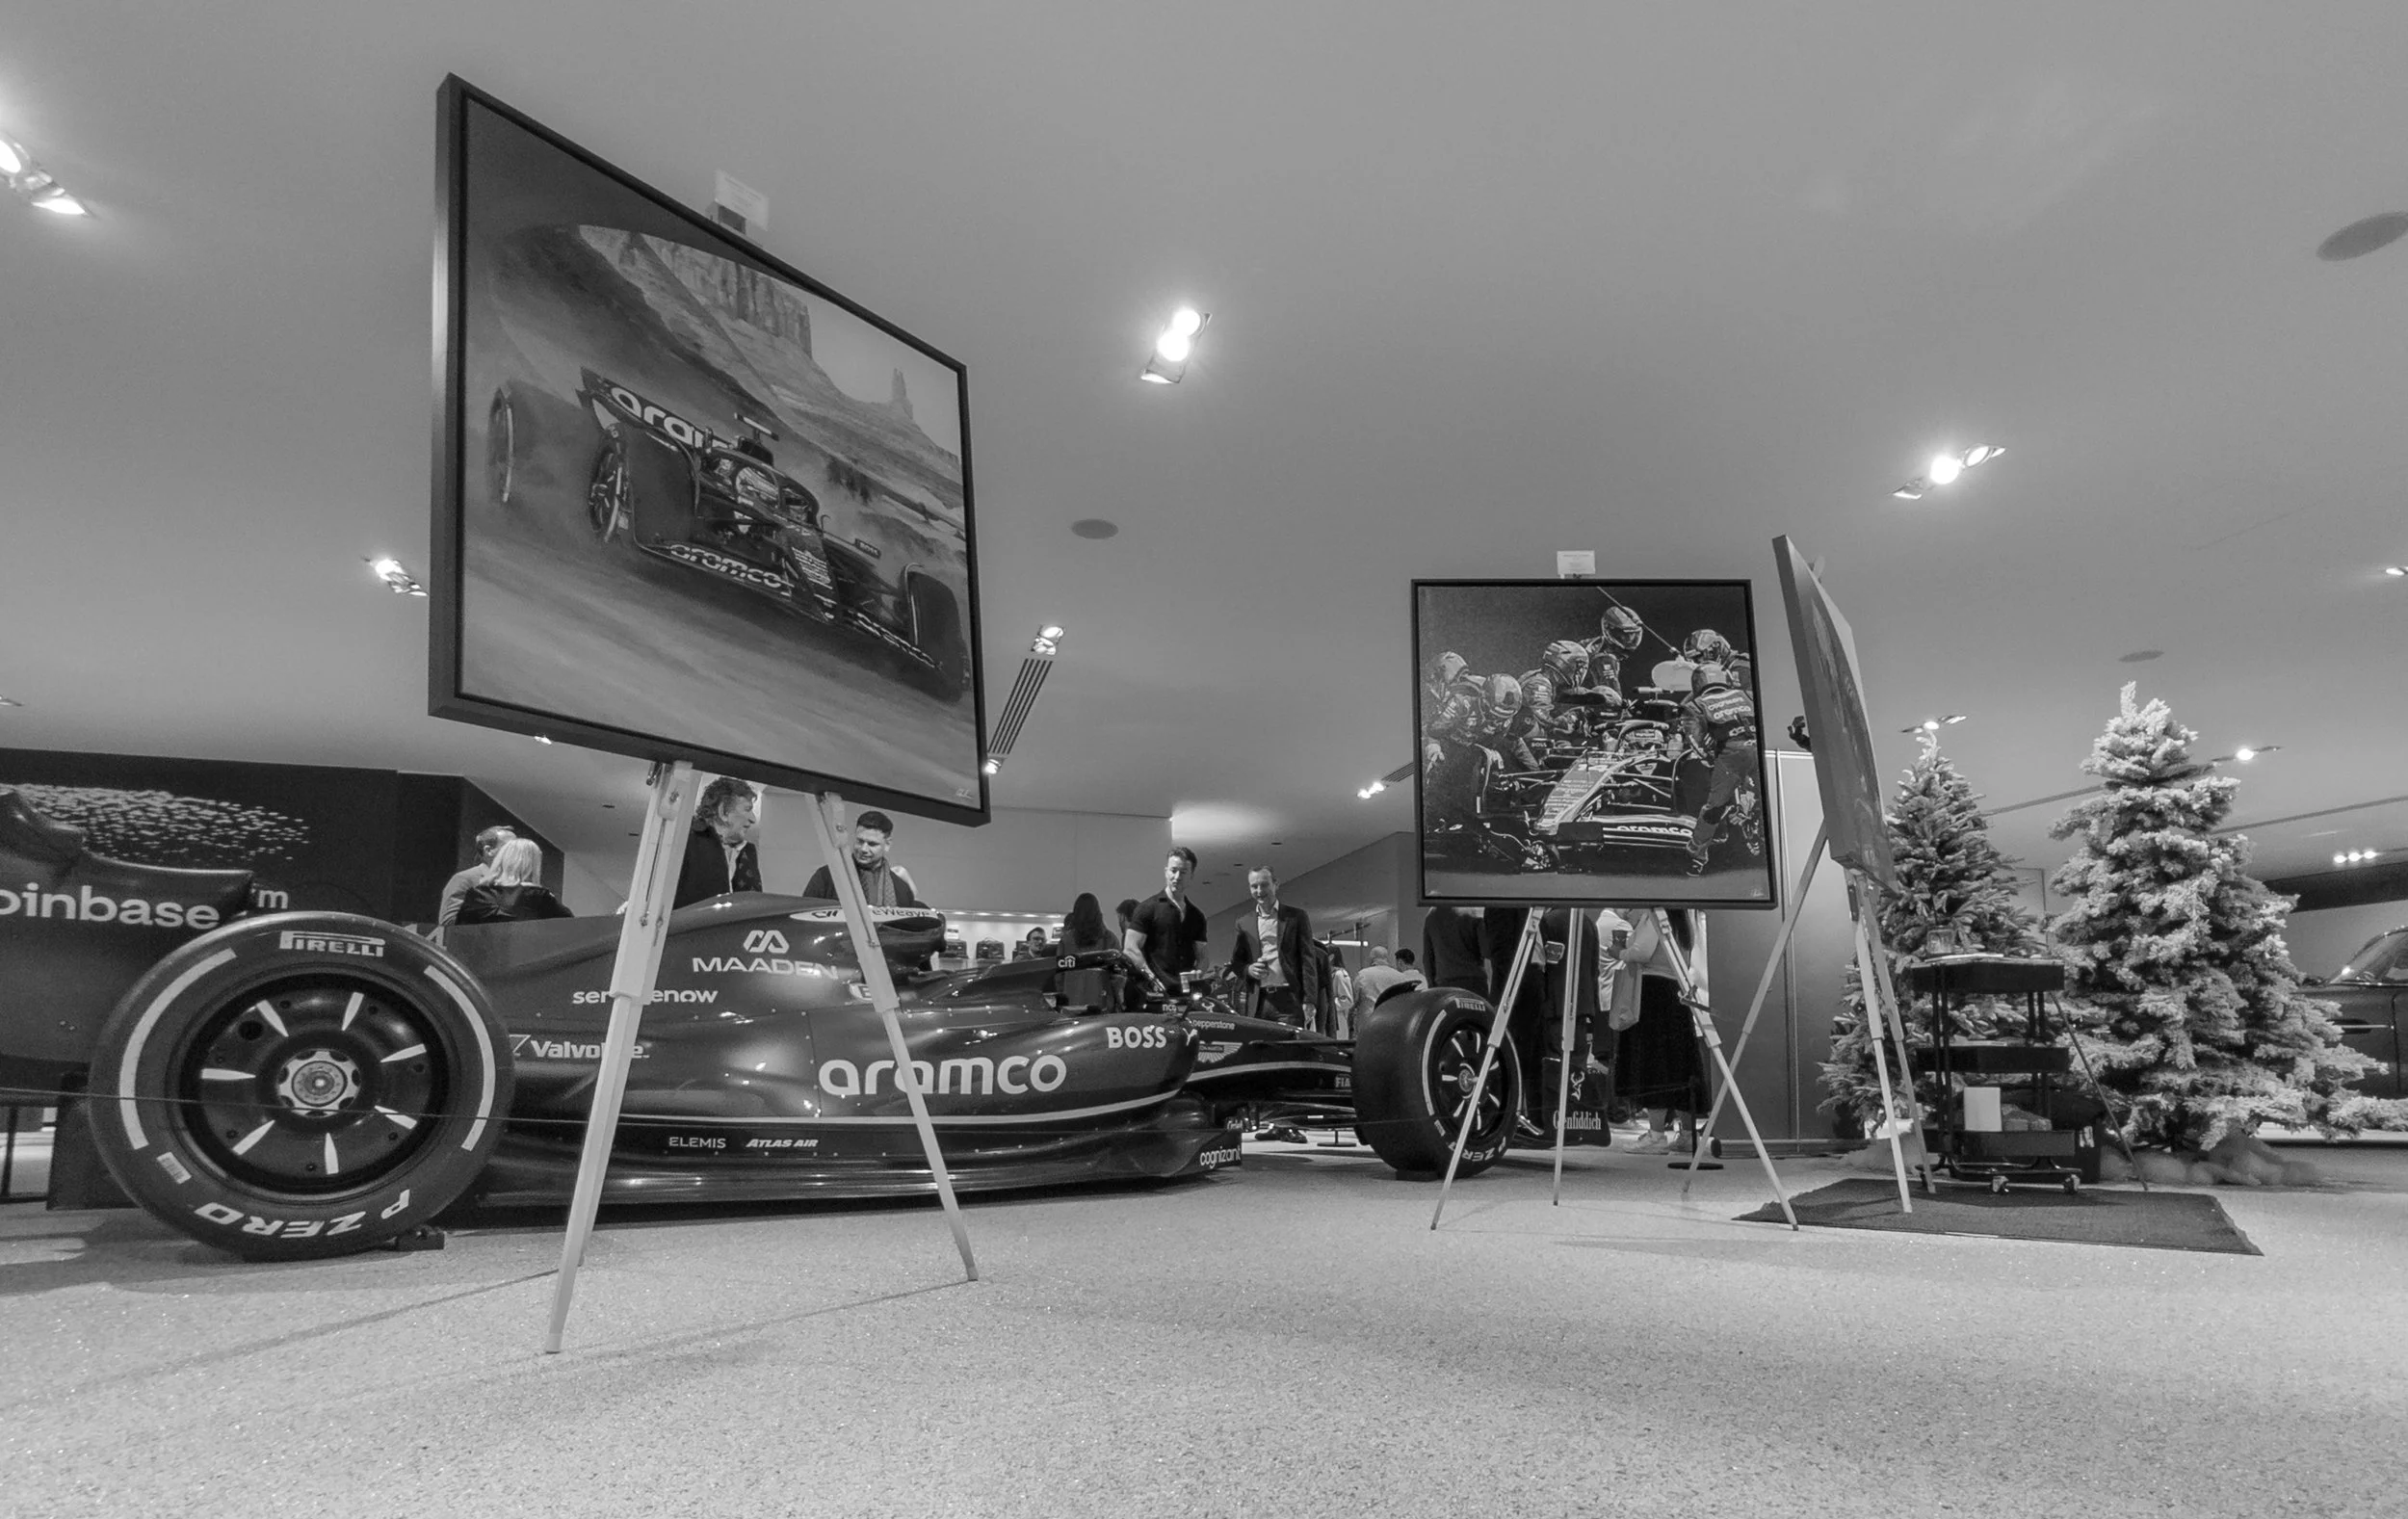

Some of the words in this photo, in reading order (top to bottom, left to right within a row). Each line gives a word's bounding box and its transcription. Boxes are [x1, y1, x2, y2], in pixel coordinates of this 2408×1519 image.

[279, 930, 385, 957] PIRELLI
[693, 957, 838, 981] MAADEN
[1058, 956, 1076, 968] citi
[572, 989, 719, 1005] serenow
[1454, 997, 1486, 1012] PIRELLI
[1106, 1027, 1167, 1049] BOSS
[531, 1040, 644, 1059] Valvoe
[819, 1055, 1066, 1096] aramco
[1335, 1077, 1350, 1087] FIA
[1553, 1110, 1601, 1130] Gnfiddich
[669, 1137, 726, 1148] ELEMIS
[746, 1139, 792, 1147] ATLAS
[1199, 1144, 1241, 1169] cognizant
[380, 1190, 410, 1219] P
[194, 1202, 366, 1239] ZERO
